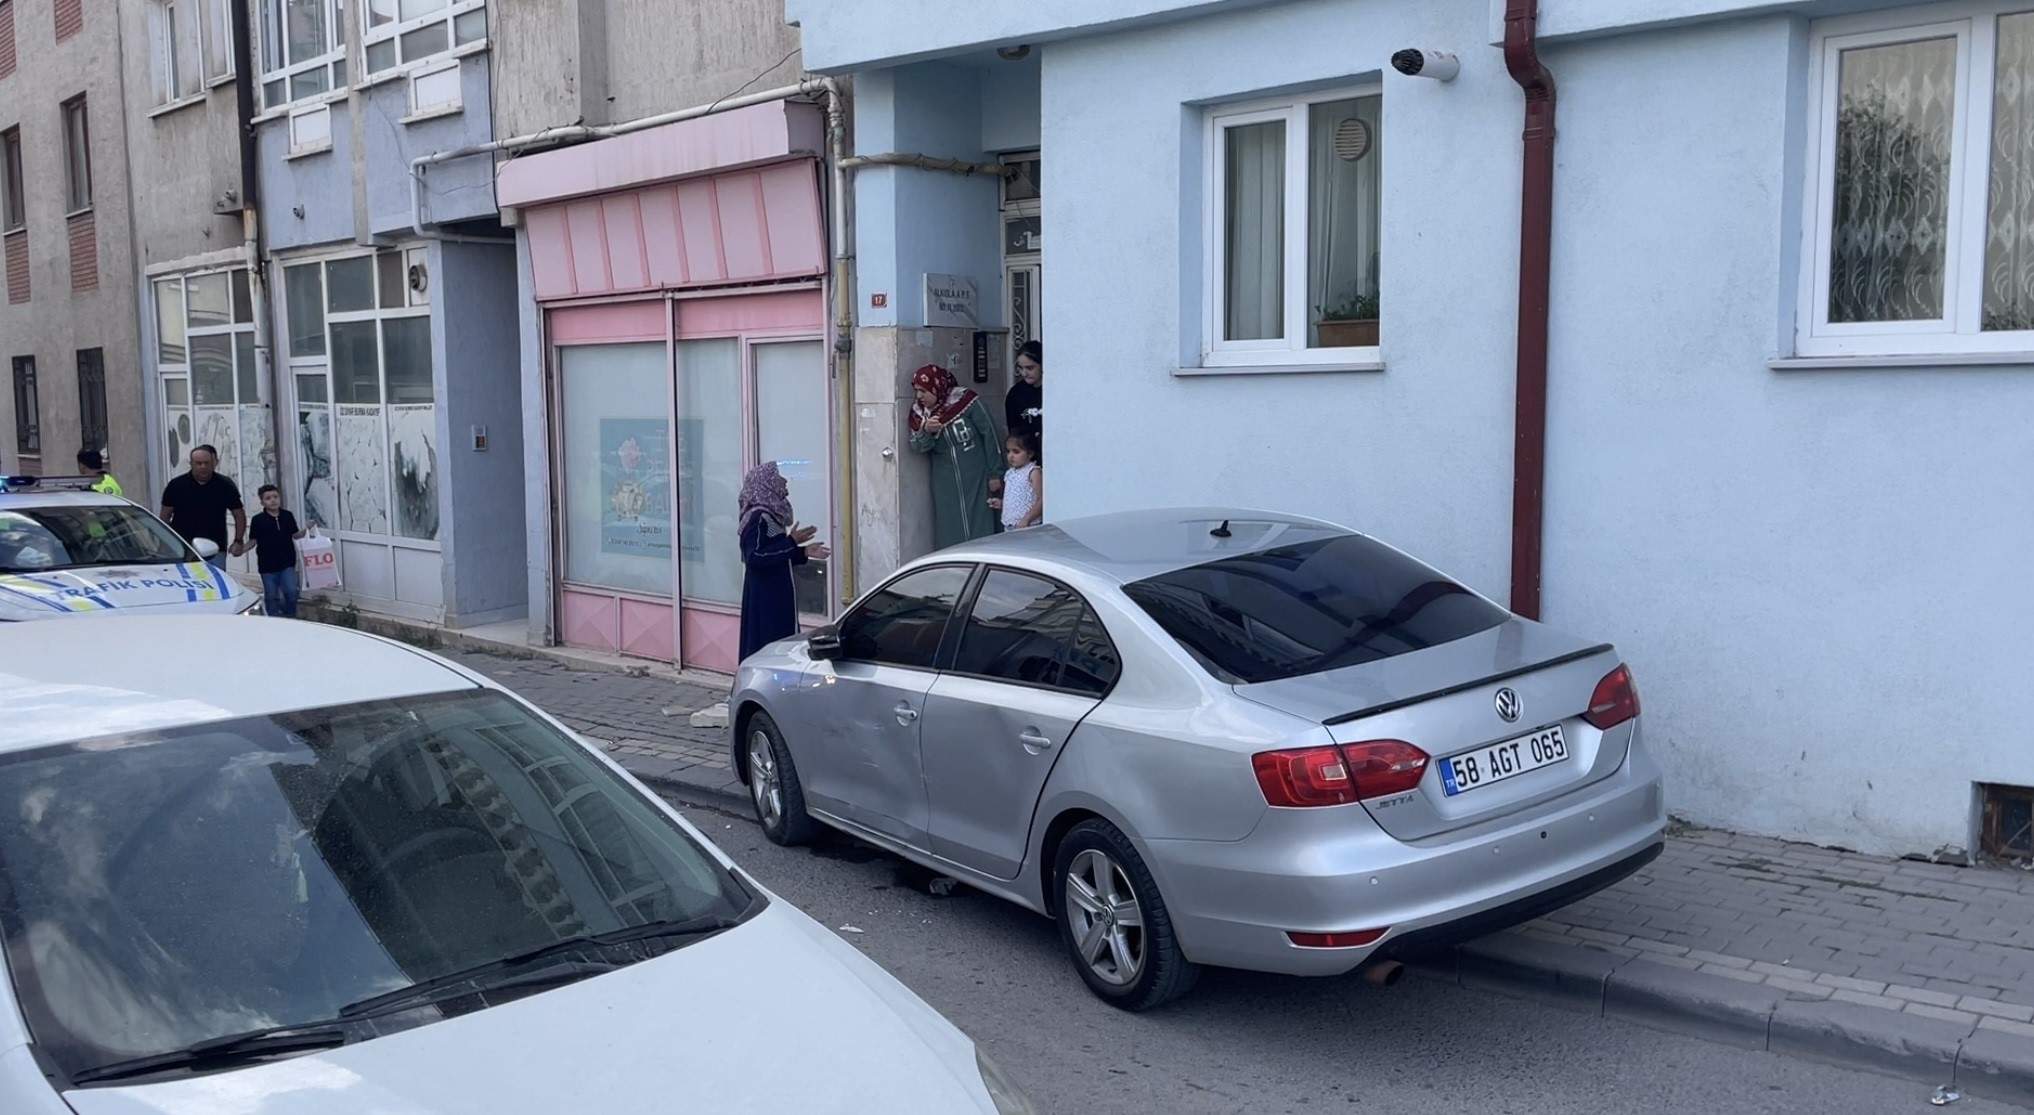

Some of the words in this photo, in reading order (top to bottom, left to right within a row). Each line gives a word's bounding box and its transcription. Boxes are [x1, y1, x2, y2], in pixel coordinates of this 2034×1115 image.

[875, 296, 883, 305] 17
[303, 552, 333, 567] FLO
[1452, 756, 1480, 788] 58
[1488, 742, 1522, 778] AGT
[1530, 730, 1565, 763] 065
[1375, 794, 1414, 810] JETTA
